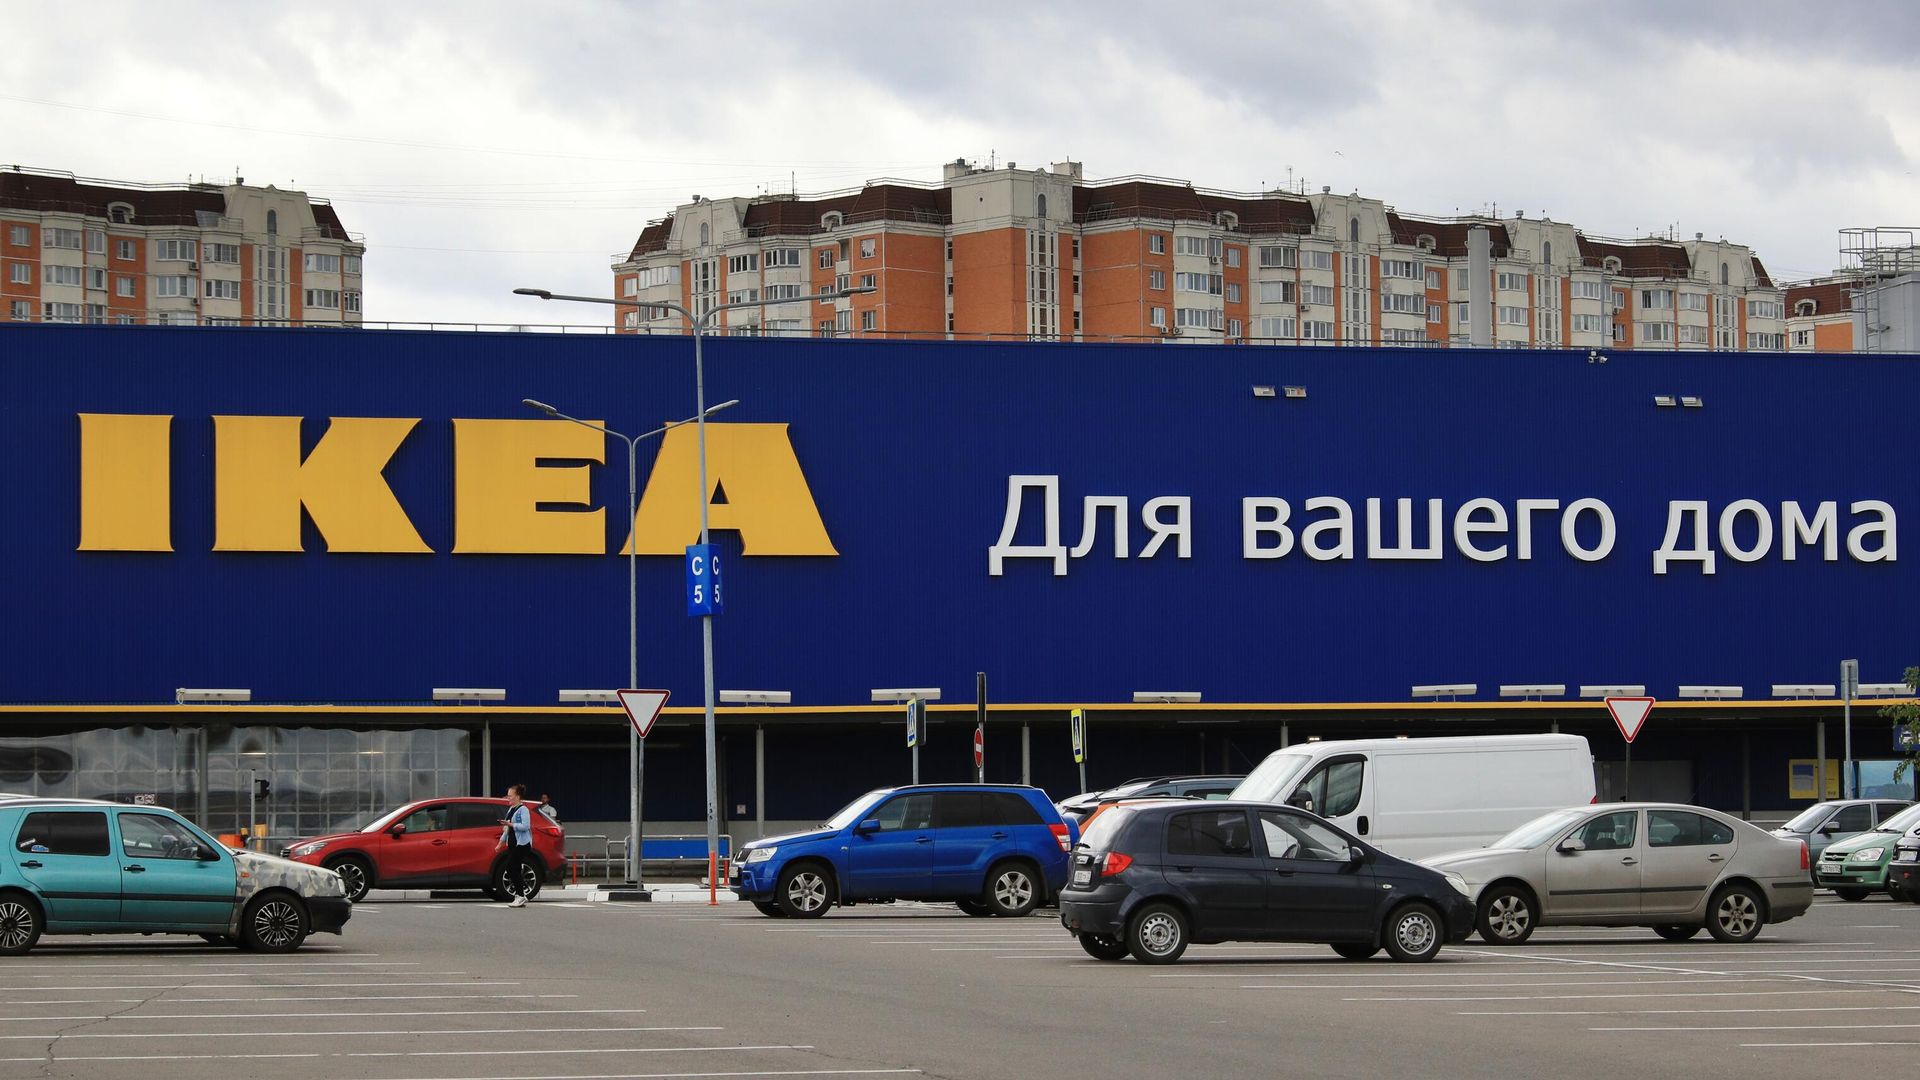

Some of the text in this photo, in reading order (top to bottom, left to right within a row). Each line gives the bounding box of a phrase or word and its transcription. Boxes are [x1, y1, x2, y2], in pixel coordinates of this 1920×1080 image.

[77, 413, 838, 556] IKEA
[988, 475, 1897, 576] Для вашего дома
[694, 584, 703, 604] 5
[714, 584, 720, 604] 5
